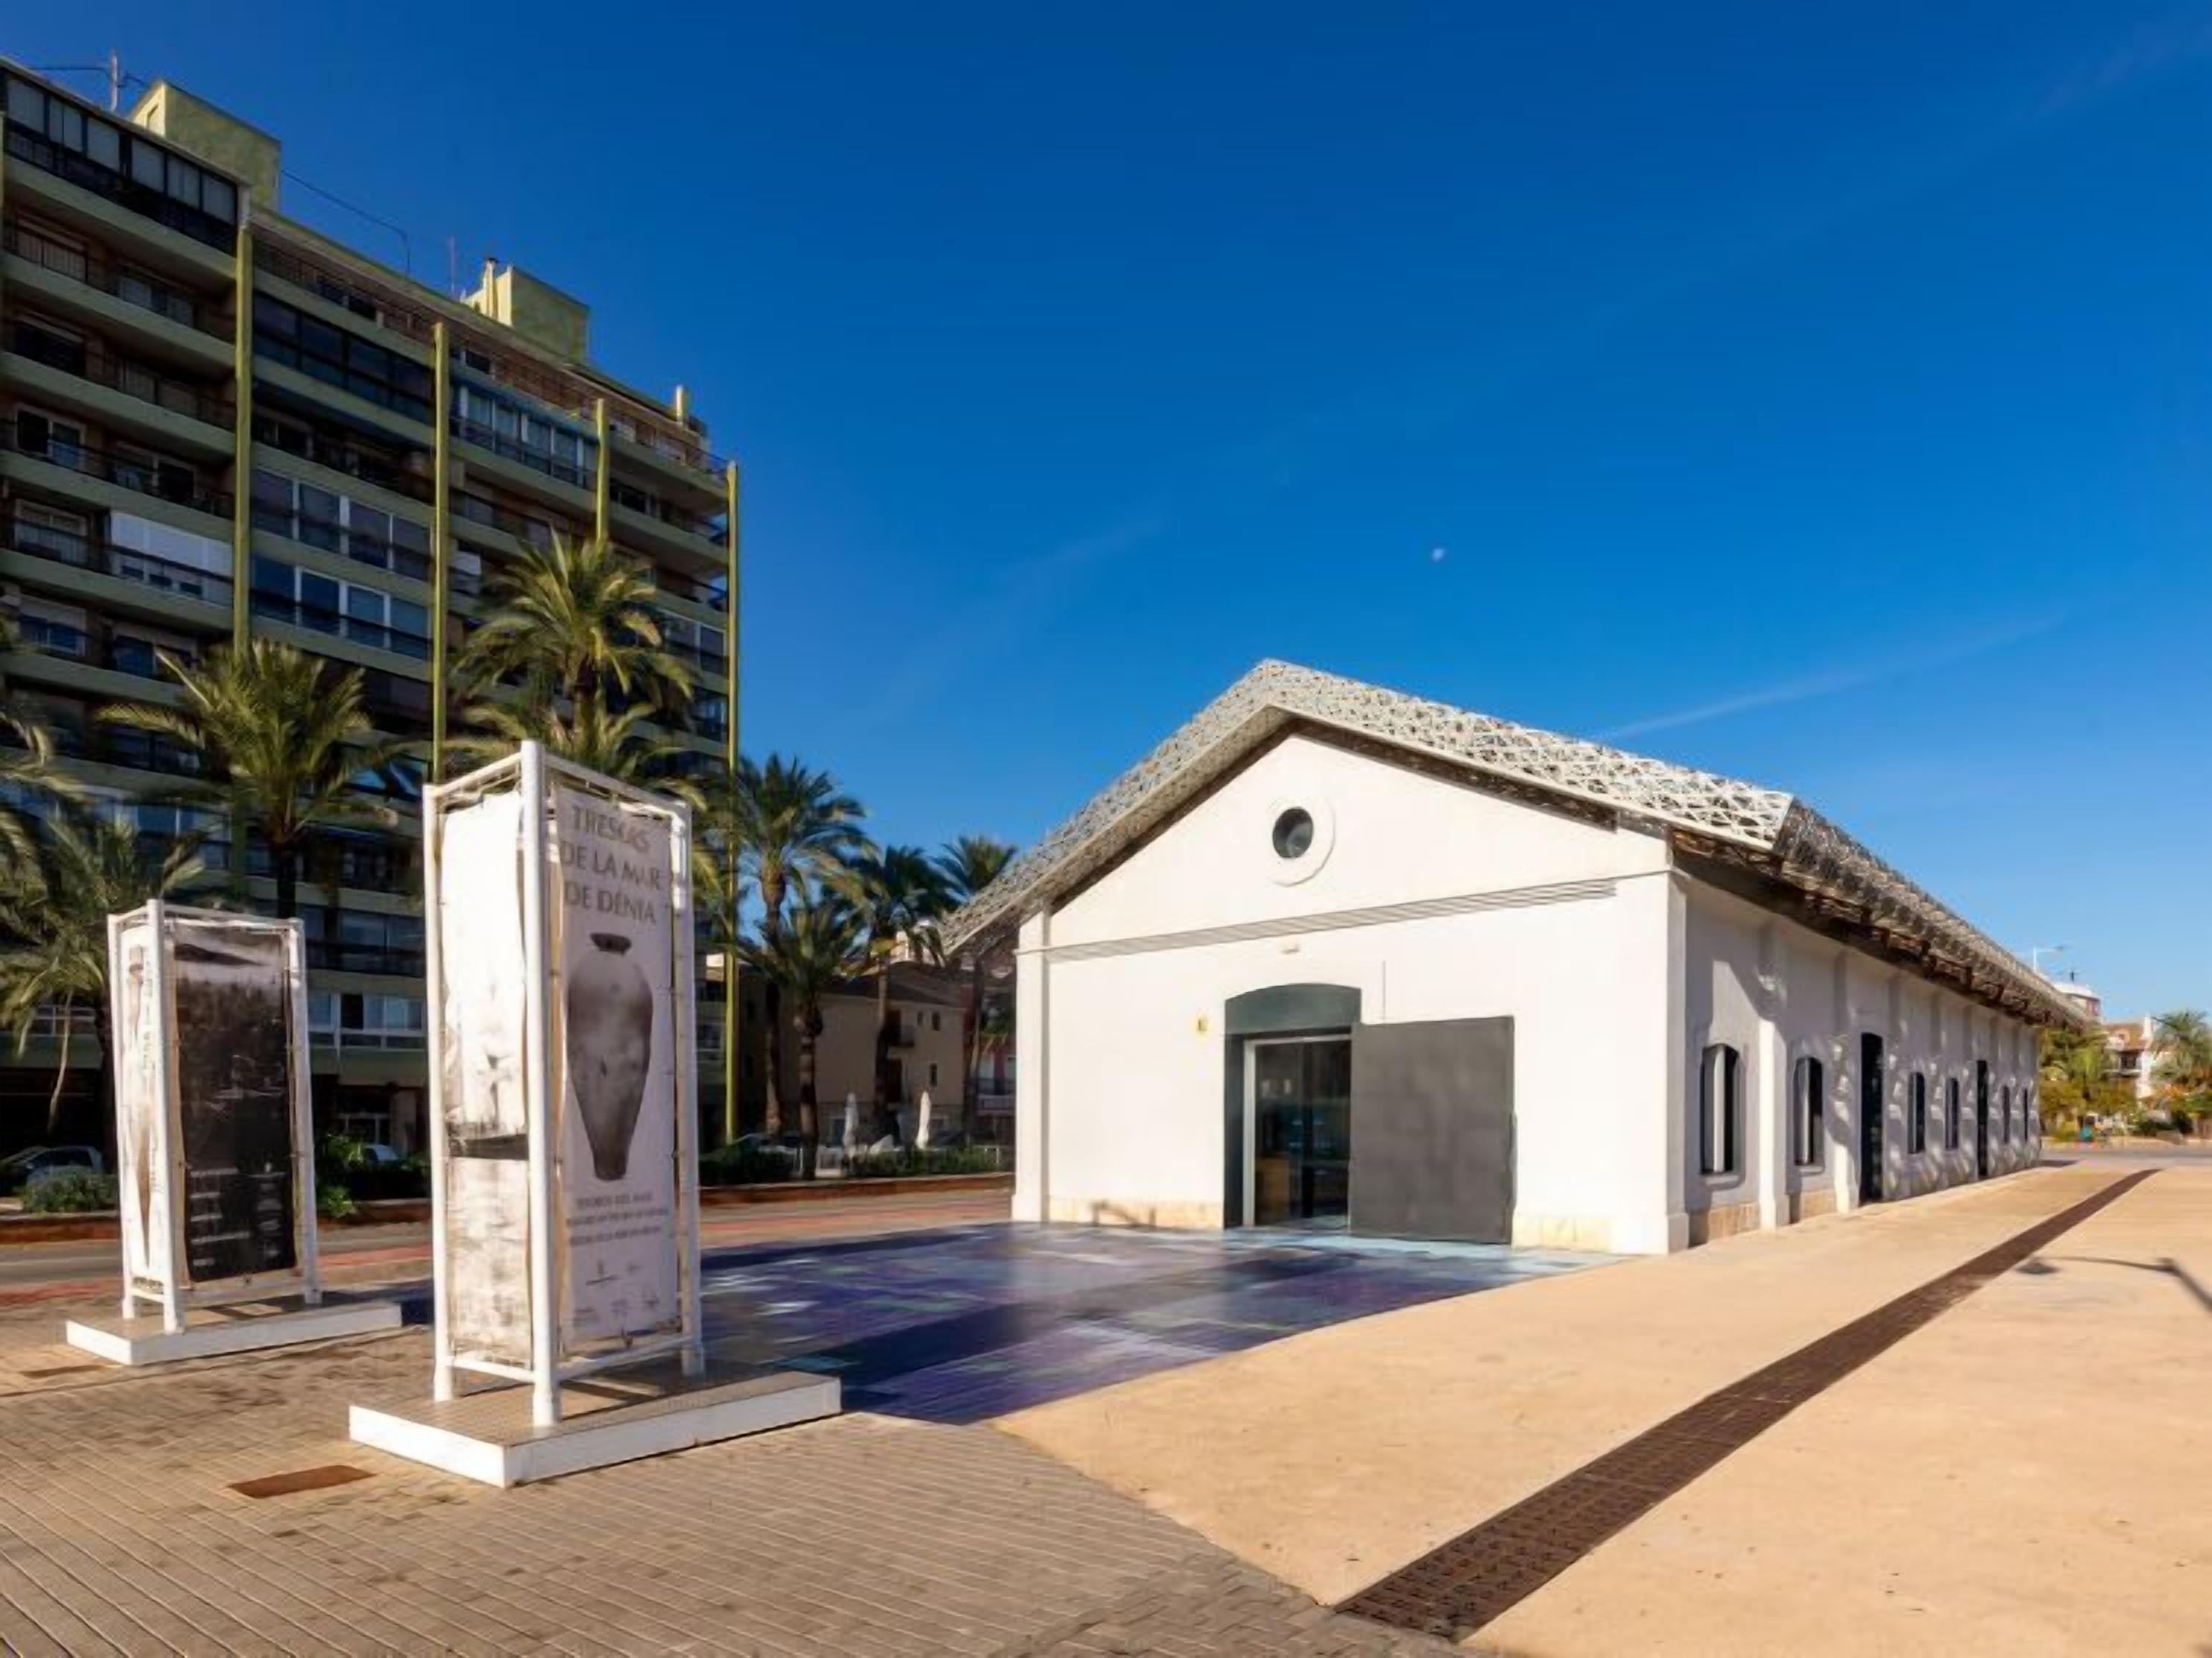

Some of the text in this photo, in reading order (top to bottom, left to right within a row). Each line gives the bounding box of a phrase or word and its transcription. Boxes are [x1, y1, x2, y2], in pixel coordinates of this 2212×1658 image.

[560, 841, 587, 870] DE
[593, 850, 617, 879] LA
[565, 881, 592, 909] DE
